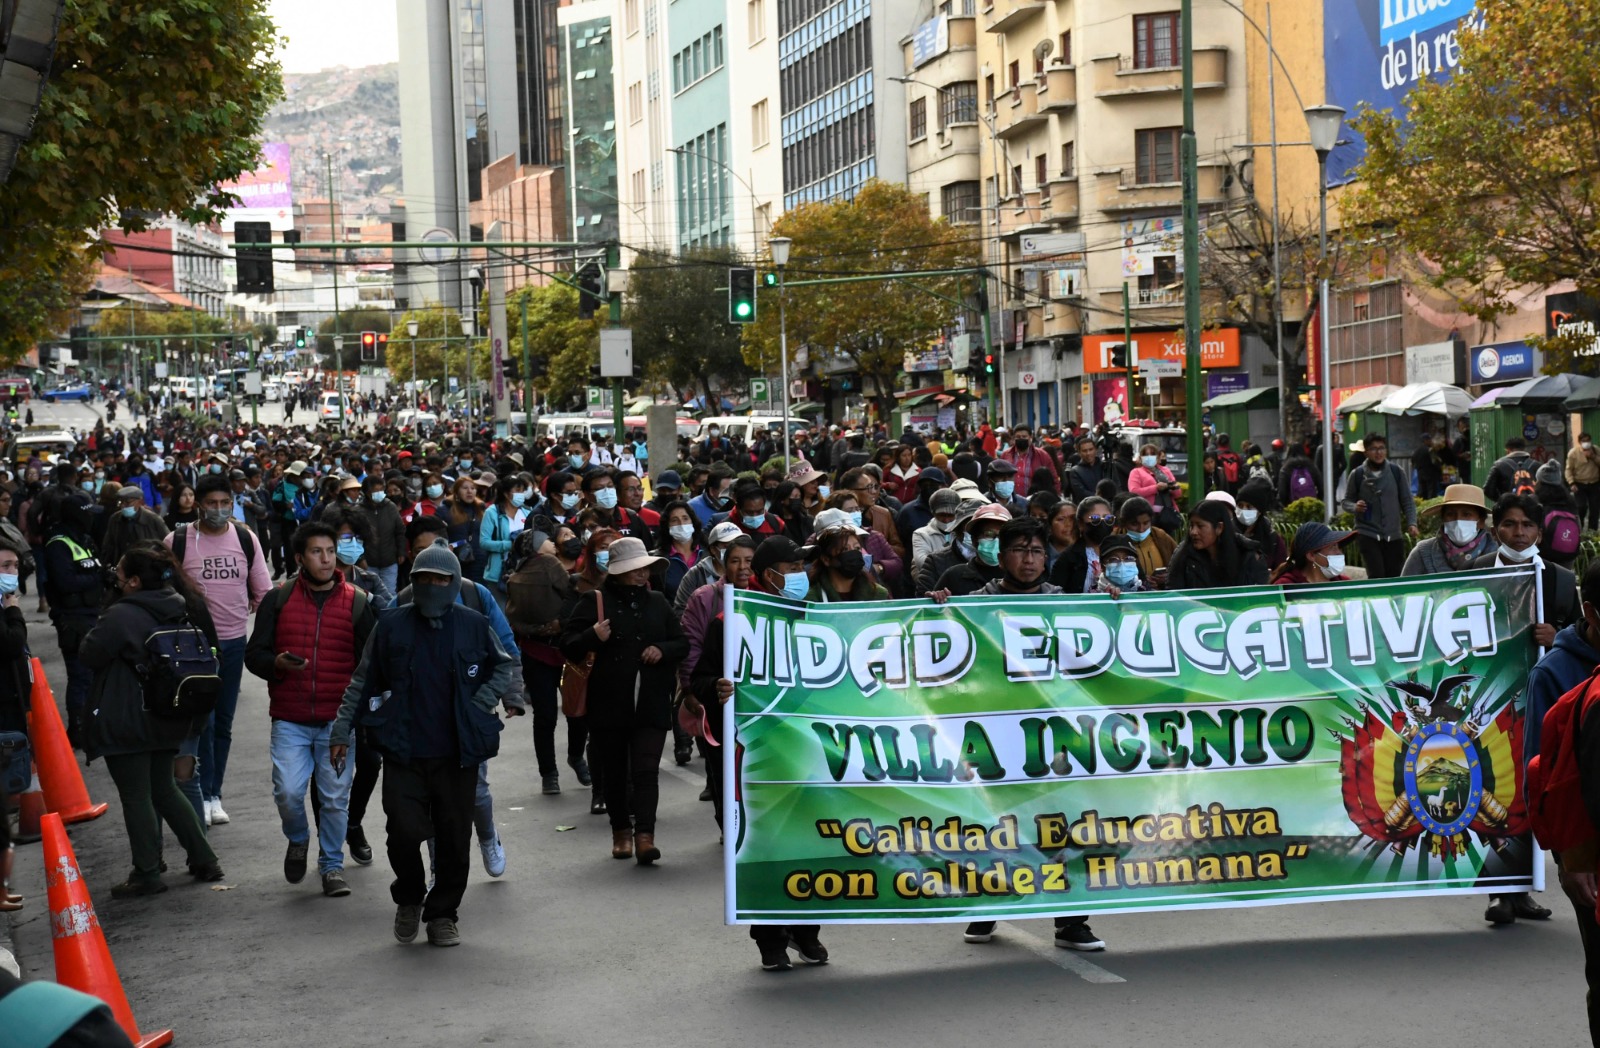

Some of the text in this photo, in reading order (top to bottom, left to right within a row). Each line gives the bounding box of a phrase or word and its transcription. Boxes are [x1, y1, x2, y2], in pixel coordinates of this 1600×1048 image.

[1381, 38, 1407, 90] de
[1410, 29, 1431, 81] la
[1163, 341, 1225, 356] xiami
[588, 388, 600, 403] P
[752, 382, 766, 399] P
[202, 568, 240, 580] GION
[203, 557, 237, 568] RELI
[1001, 588, 1497, 680] EDUCATIVA
[811, 705, 1314, 782] VILLA INGENIO
[1035, 801, 1282, 851] Educativa
[784, 868, 879, 900] con
[894, 858, 1071, 900] calidez
